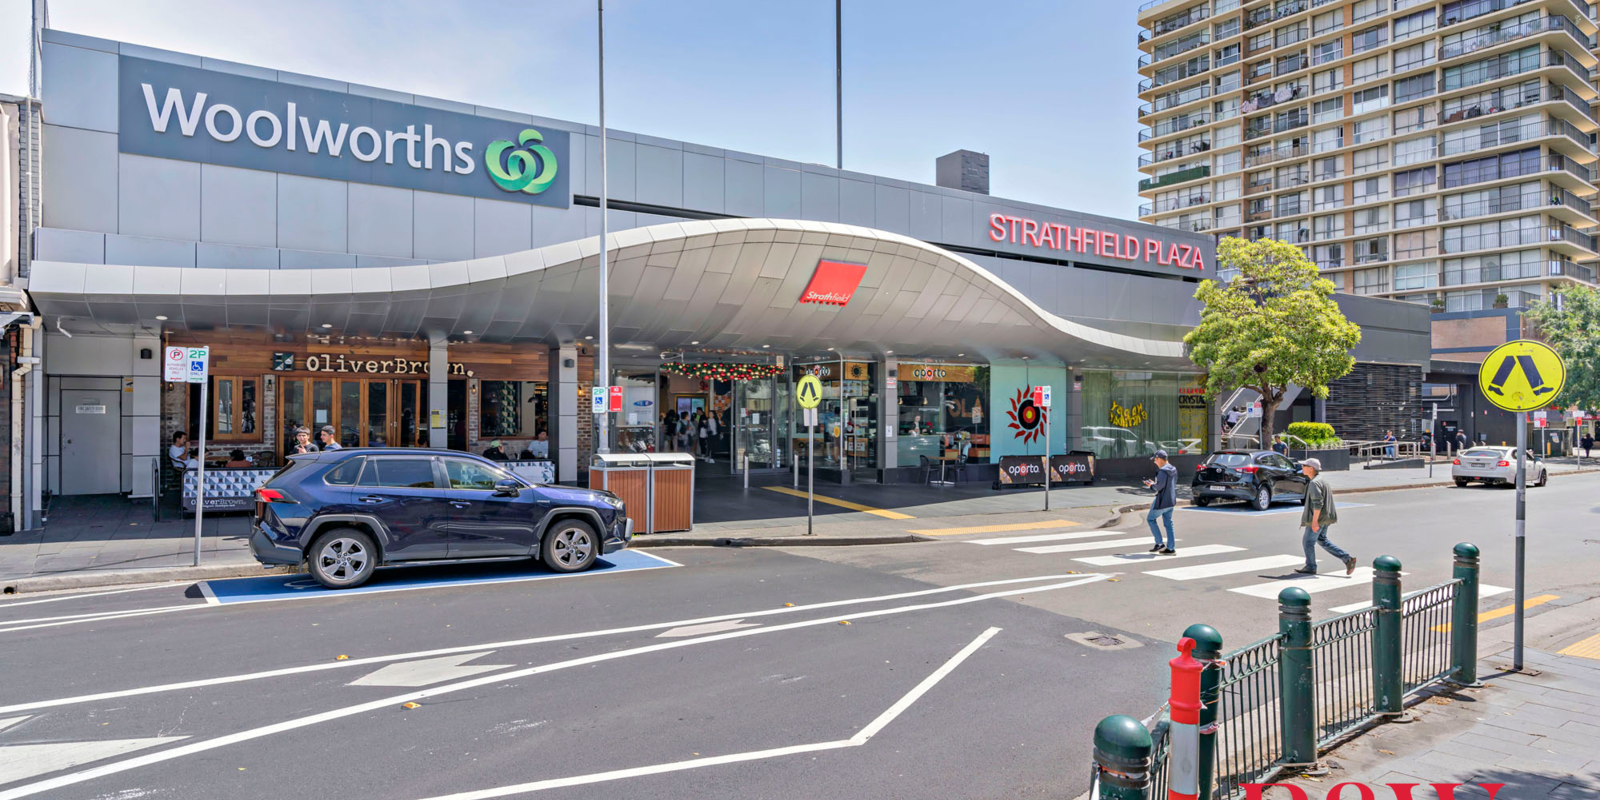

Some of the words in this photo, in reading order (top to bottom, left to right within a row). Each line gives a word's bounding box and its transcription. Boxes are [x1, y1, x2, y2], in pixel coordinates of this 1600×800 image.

[141, 82, 476, 175] Woolworths
[989, 213, 1140, 261] STRATHFIELD
[1144, 238, 1205, 270] PLAZA
[806, 291, 851, 302] Strathfield
[189, 350, 207, 359] 2P
[913, 367, 946, 379] oporto
